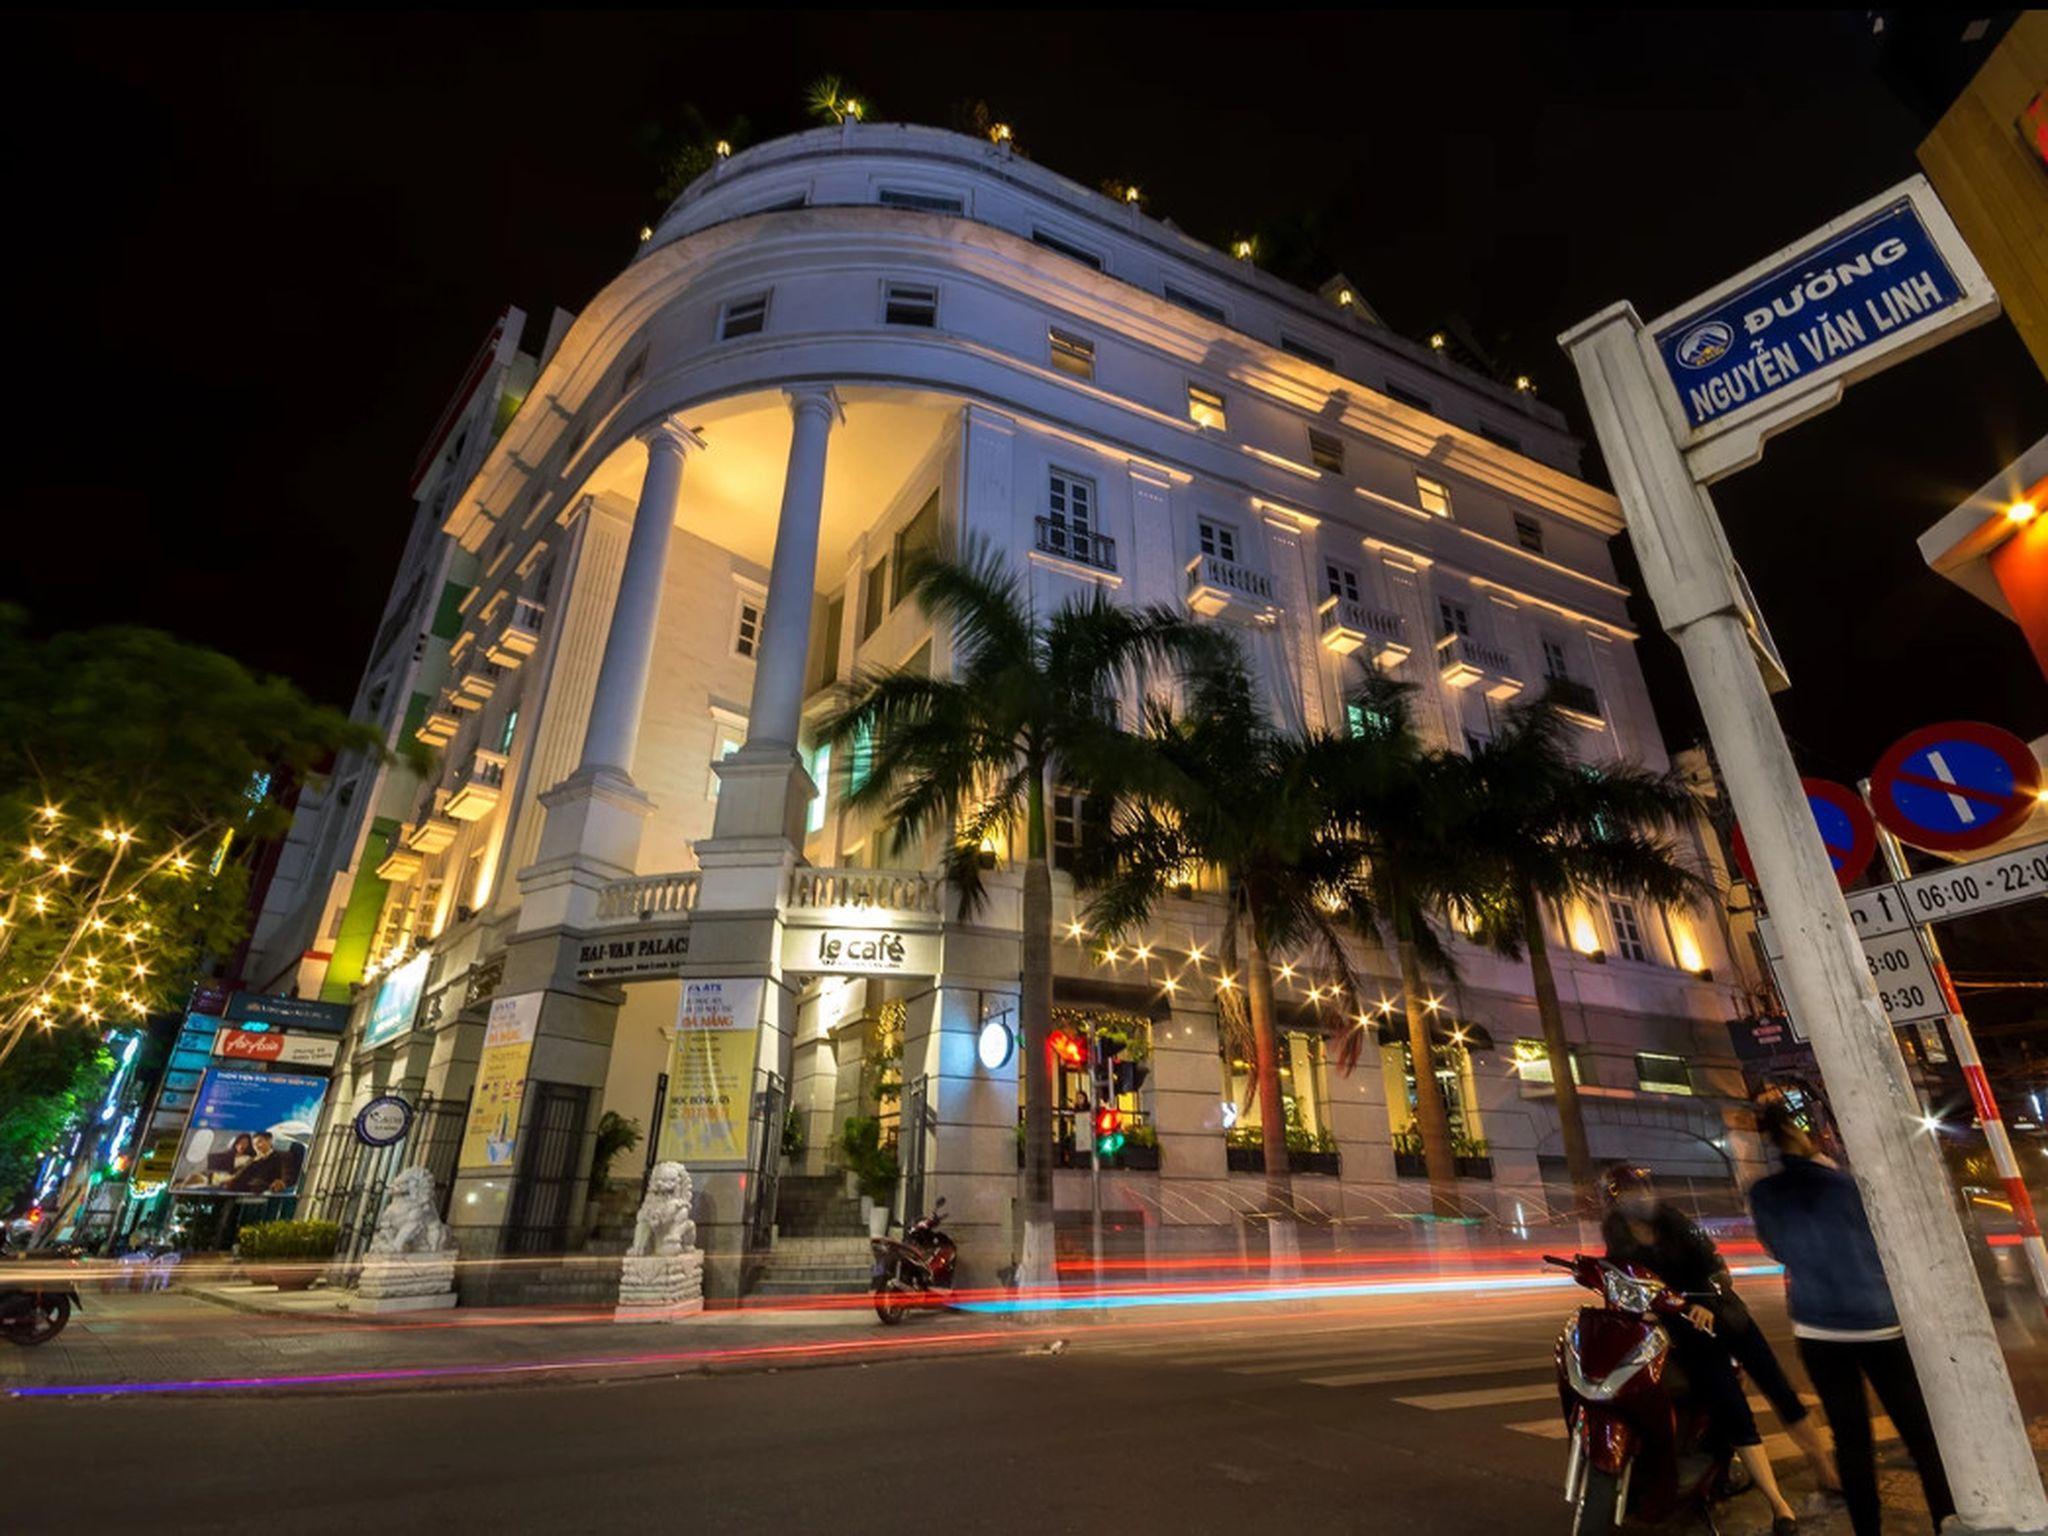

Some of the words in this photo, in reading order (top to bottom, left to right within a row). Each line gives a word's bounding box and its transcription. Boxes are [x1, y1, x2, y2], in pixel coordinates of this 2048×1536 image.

[1743, 237, 1908, 336] ĐƯỜNG
[1689, 337, 1800, 422] NGUYỄN
[1799, 309, 1867, 364] VĂN
[1865, 271, 1943, 332] LINH
[1917, 876, 1979, 911] 06:00
[819, 931, 842, 960] le
[847, 933, 905, 962] café
